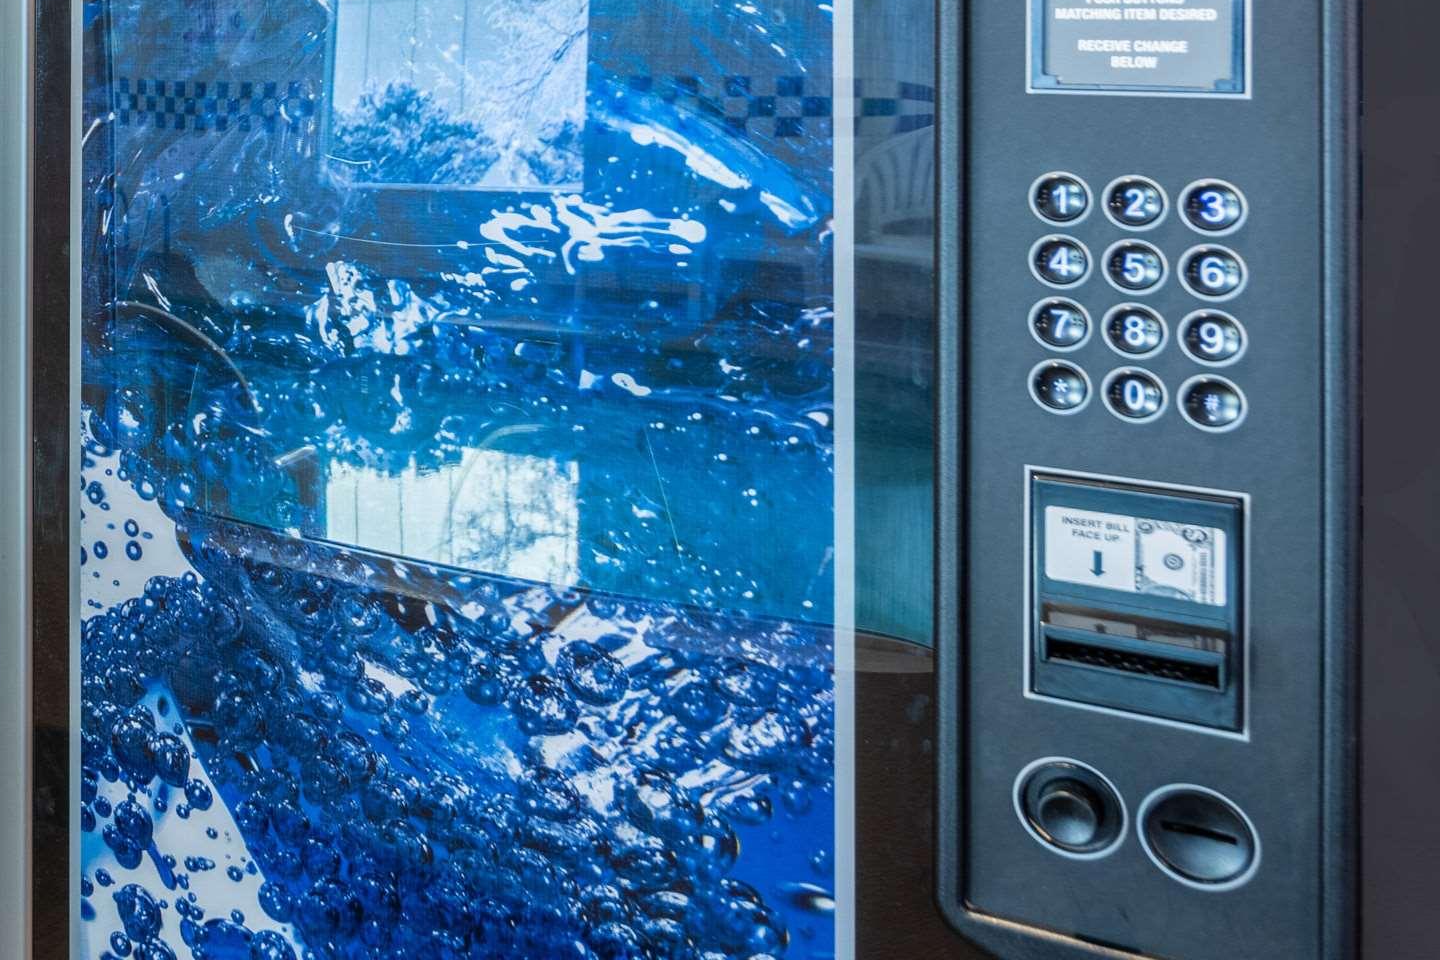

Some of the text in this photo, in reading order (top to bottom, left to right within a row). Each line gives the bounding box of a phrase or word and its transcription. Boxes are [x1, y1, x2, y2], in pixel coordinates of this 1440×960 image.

[1055, 8, 1218, 21] MATCHING ITEM DESIRED
[1078, 39, 1189, 53] RECEIVE CHANGE
[1111, 56, 1158, 68] BELOW
[1052, 185, 1225, 223] 1 2 3
[1049, 247, 1225, 288] 4 5 6
[1050, 309, 1224, 354] 7 8 9
[1124, 380, 1144, 411] 0
[1062, 516, 1130, 533] INSERT BILL
[1072, 529, 1120, 542] FACE UP
